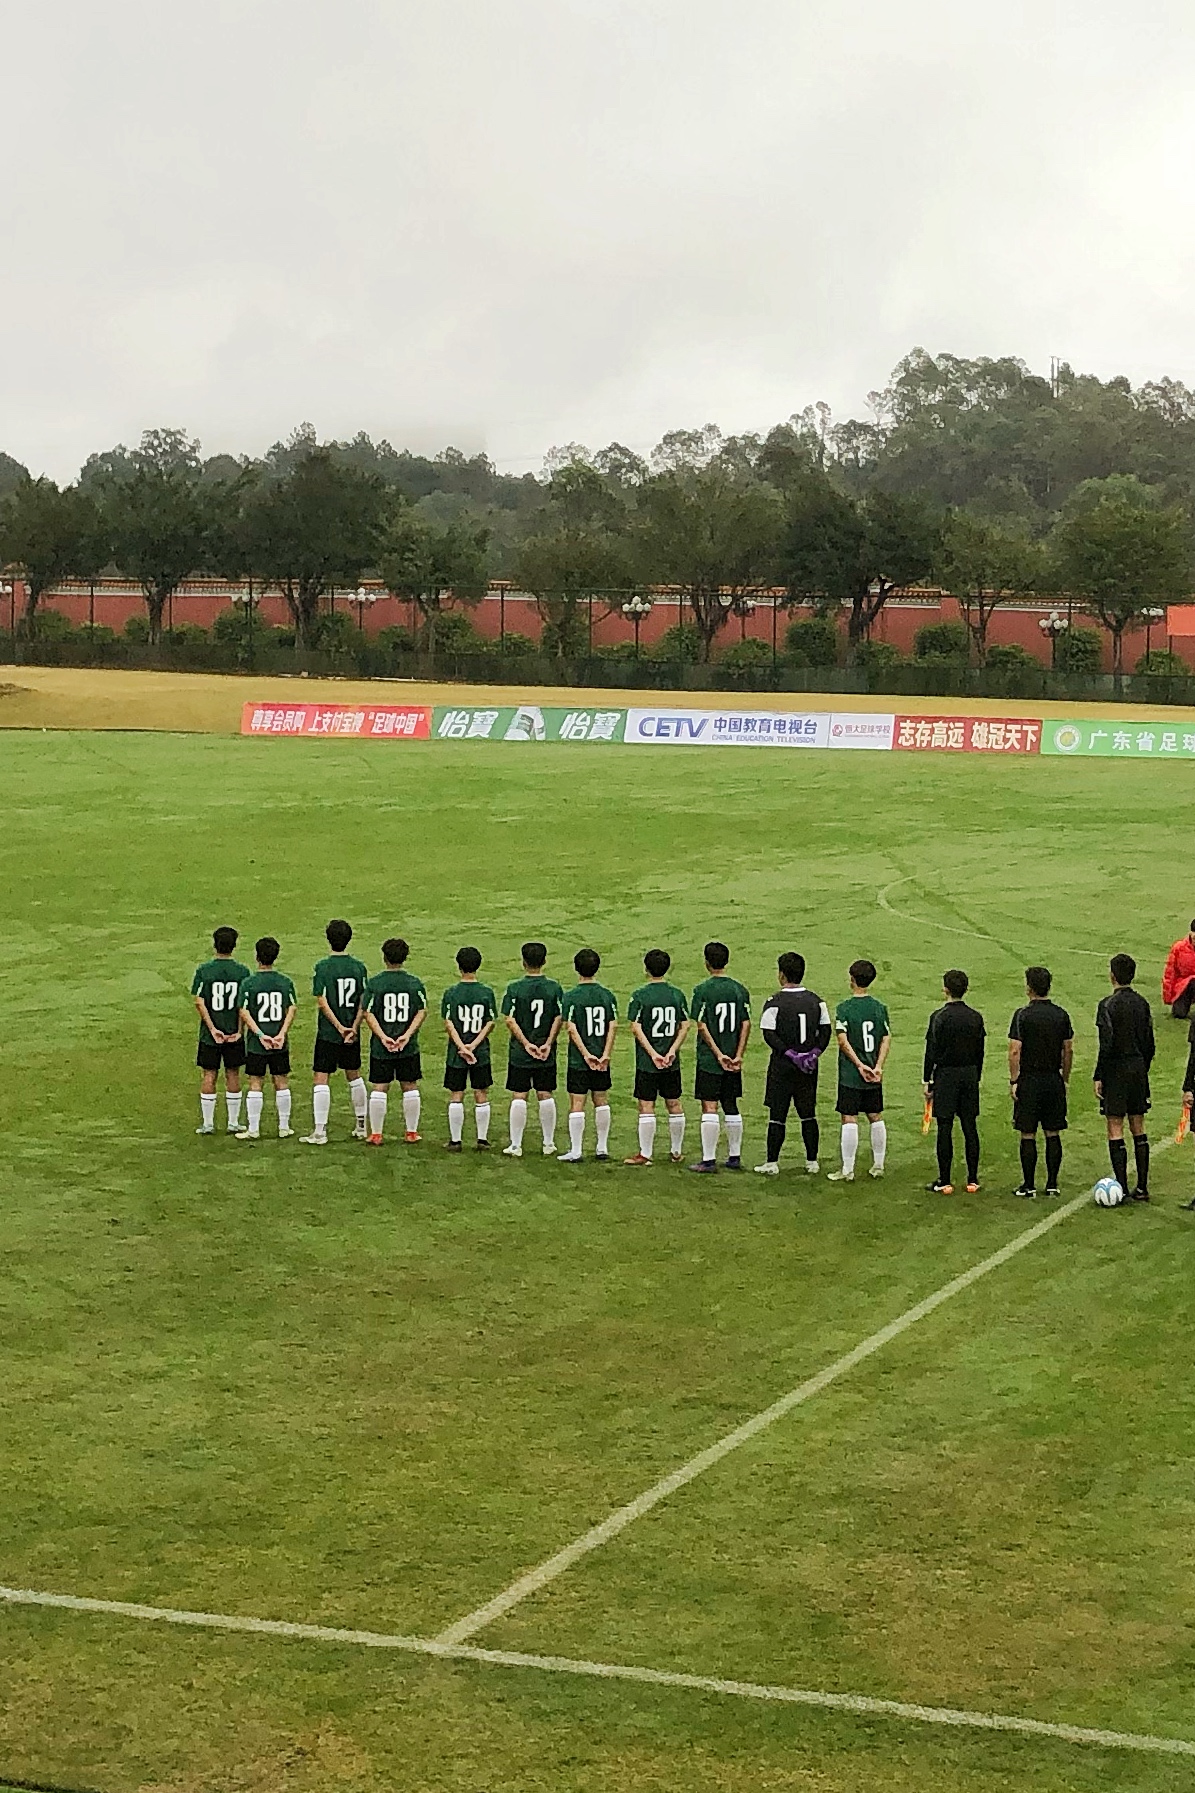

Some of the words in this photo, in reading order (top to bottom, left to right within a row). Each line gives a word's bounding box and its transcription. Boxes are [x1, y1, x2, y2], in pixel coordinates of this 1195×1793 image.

[638, 717, 709, 738] CETV
[713, 717, 817, 735] 中国教育电视台
[898, 720, 965, 747] 志存高远
[971, 721, 1039, 750] 雄冠天下
[211, 981, 238, 1011] 87
[257, 992, 282, 1022] 28
[337, 978, 356, 1007] 12
[383, 993, 410, 1022] 89
[458, 1004, 485, 1034] 48
[530, 999, 545, 1029] 7
[585, 1006, 606, 1036] 13
[652, 1006, 676, 1037] 29
[715, 1002, 736, 1033] 71
[798, 1013, 807, 1044] 1
[862, 1021, 875, 1052] 6
